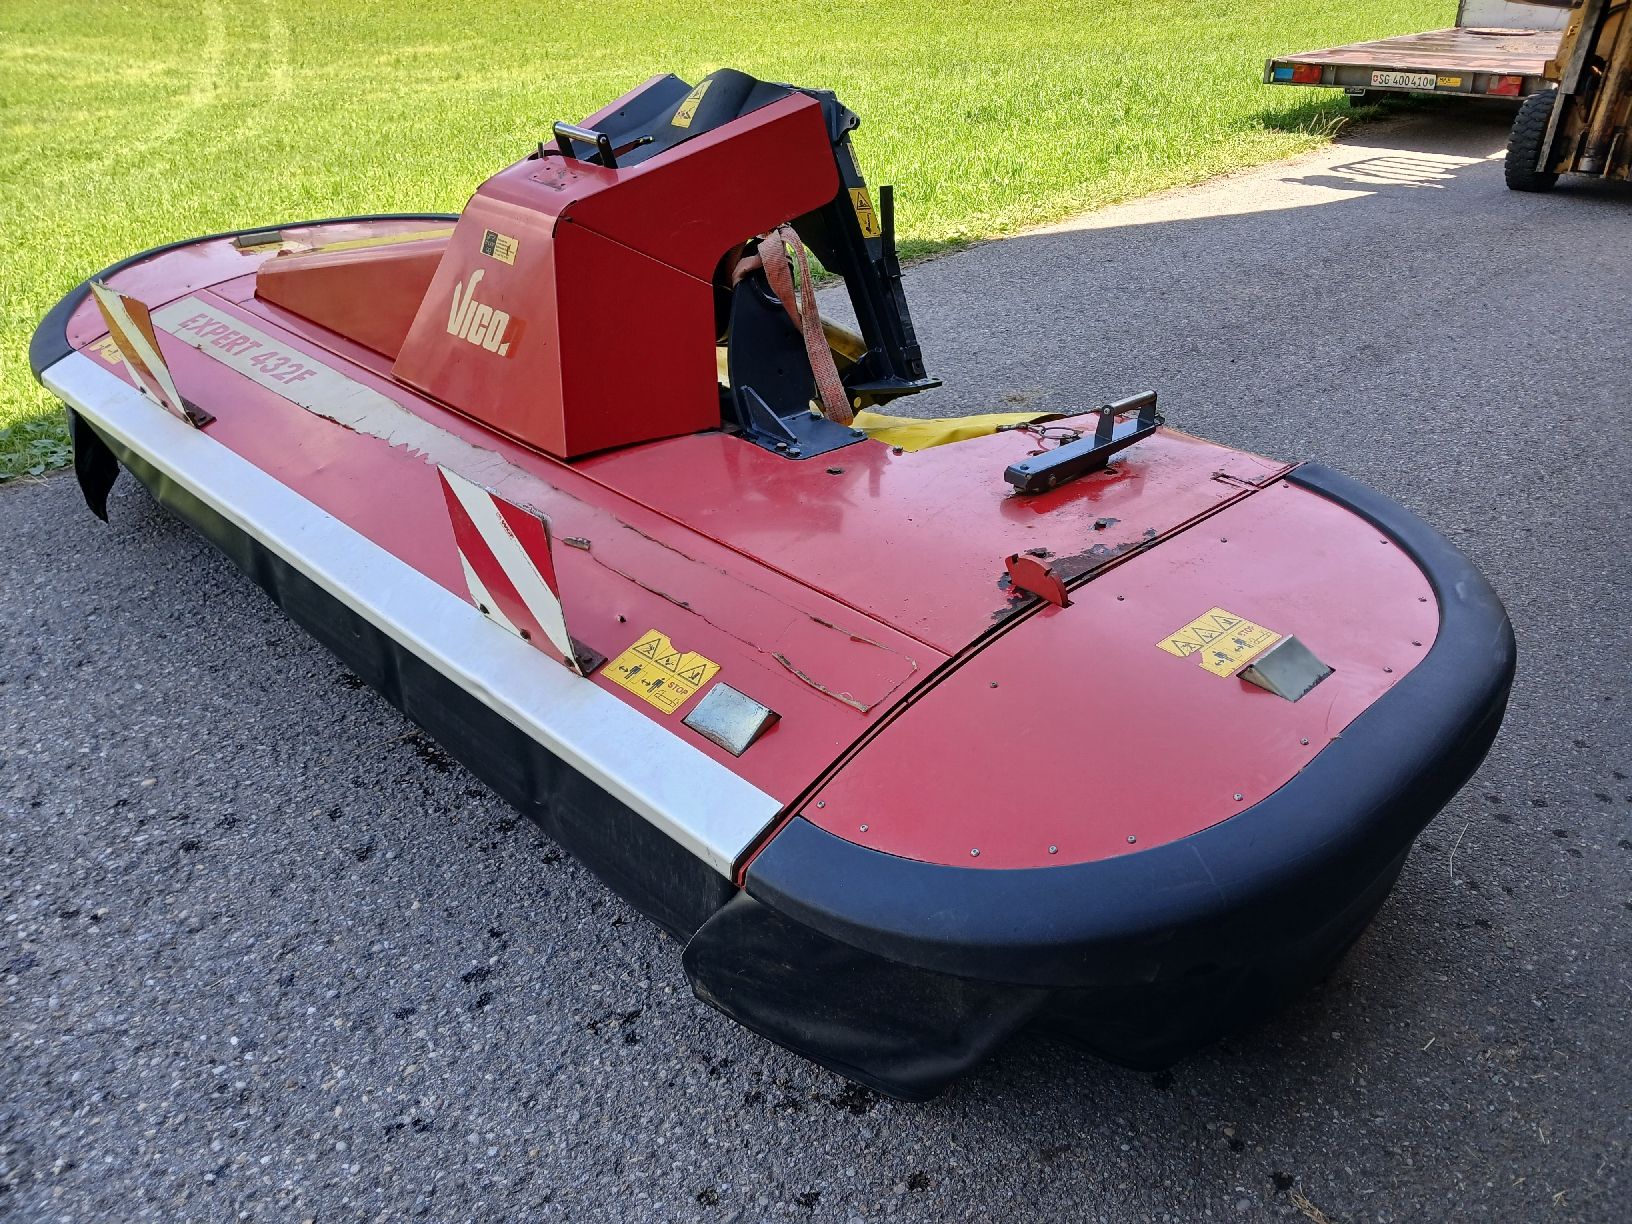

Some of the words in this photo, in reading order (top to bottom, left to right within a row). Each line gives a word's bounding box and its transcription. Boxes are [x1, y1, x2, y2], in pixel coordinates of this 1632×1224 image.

[1378, 74, 1390, 85] SG
[1393, 74, 1428, 87] 400410
[178, 313, 262, 357] EXPERT
[249, 351, 317, 385] 432F
[1237, 625, 1254, 637] STOP
[667, 681, 688, 695] STOP
